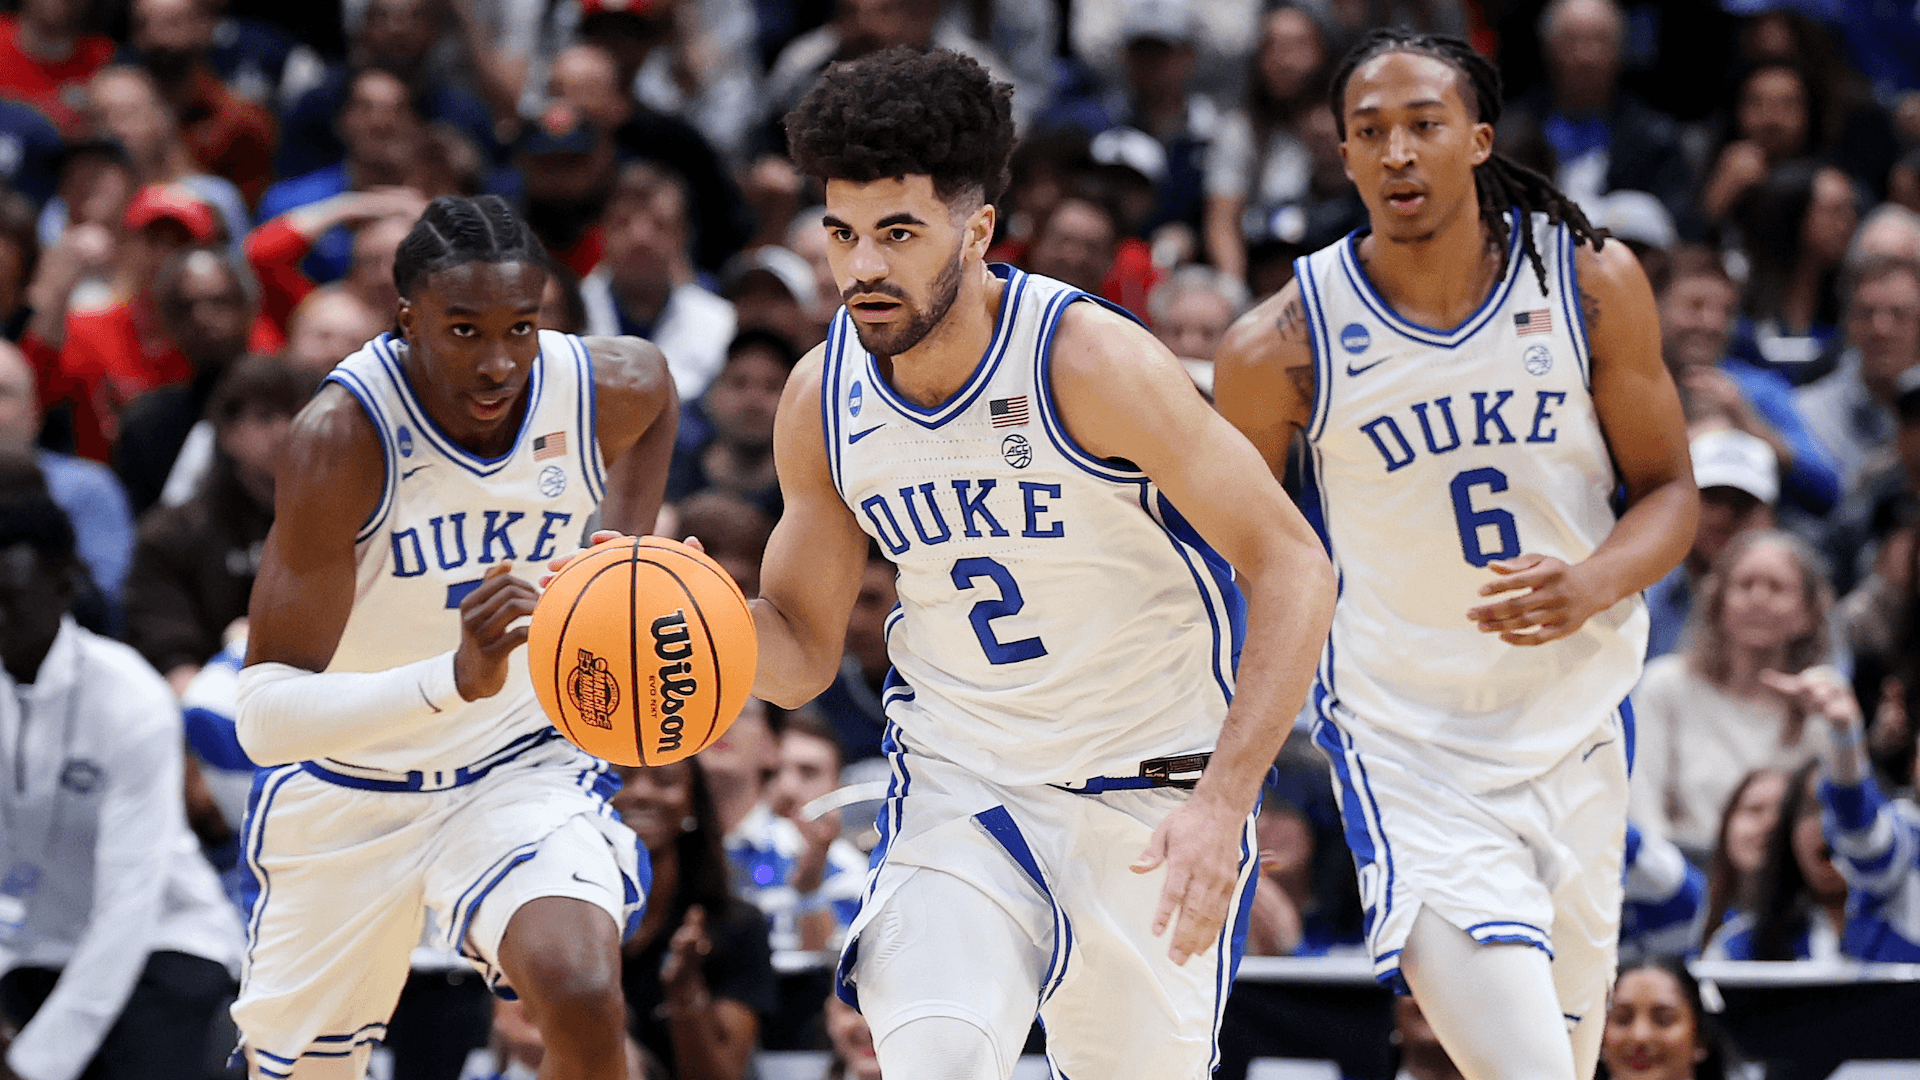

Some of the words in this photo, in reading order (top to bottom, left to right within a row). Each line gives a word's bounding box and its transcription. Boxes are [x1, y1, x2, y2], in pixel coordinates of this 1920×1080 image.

[1359, 390, 1567, 473] DUKE
[391, 510, 573, 577] DUKE
[861, 479, 1065, 555] DUKE
[1450, 466, 1521, 568] 6
[950, 556, 1048, 665] 2
[581, 670, 597, 726] MADNESS
[593, 669, 607, 713] MARCH
[649, 675, 657, 696] EVO
[651, 609, 697, 754] Wilson
